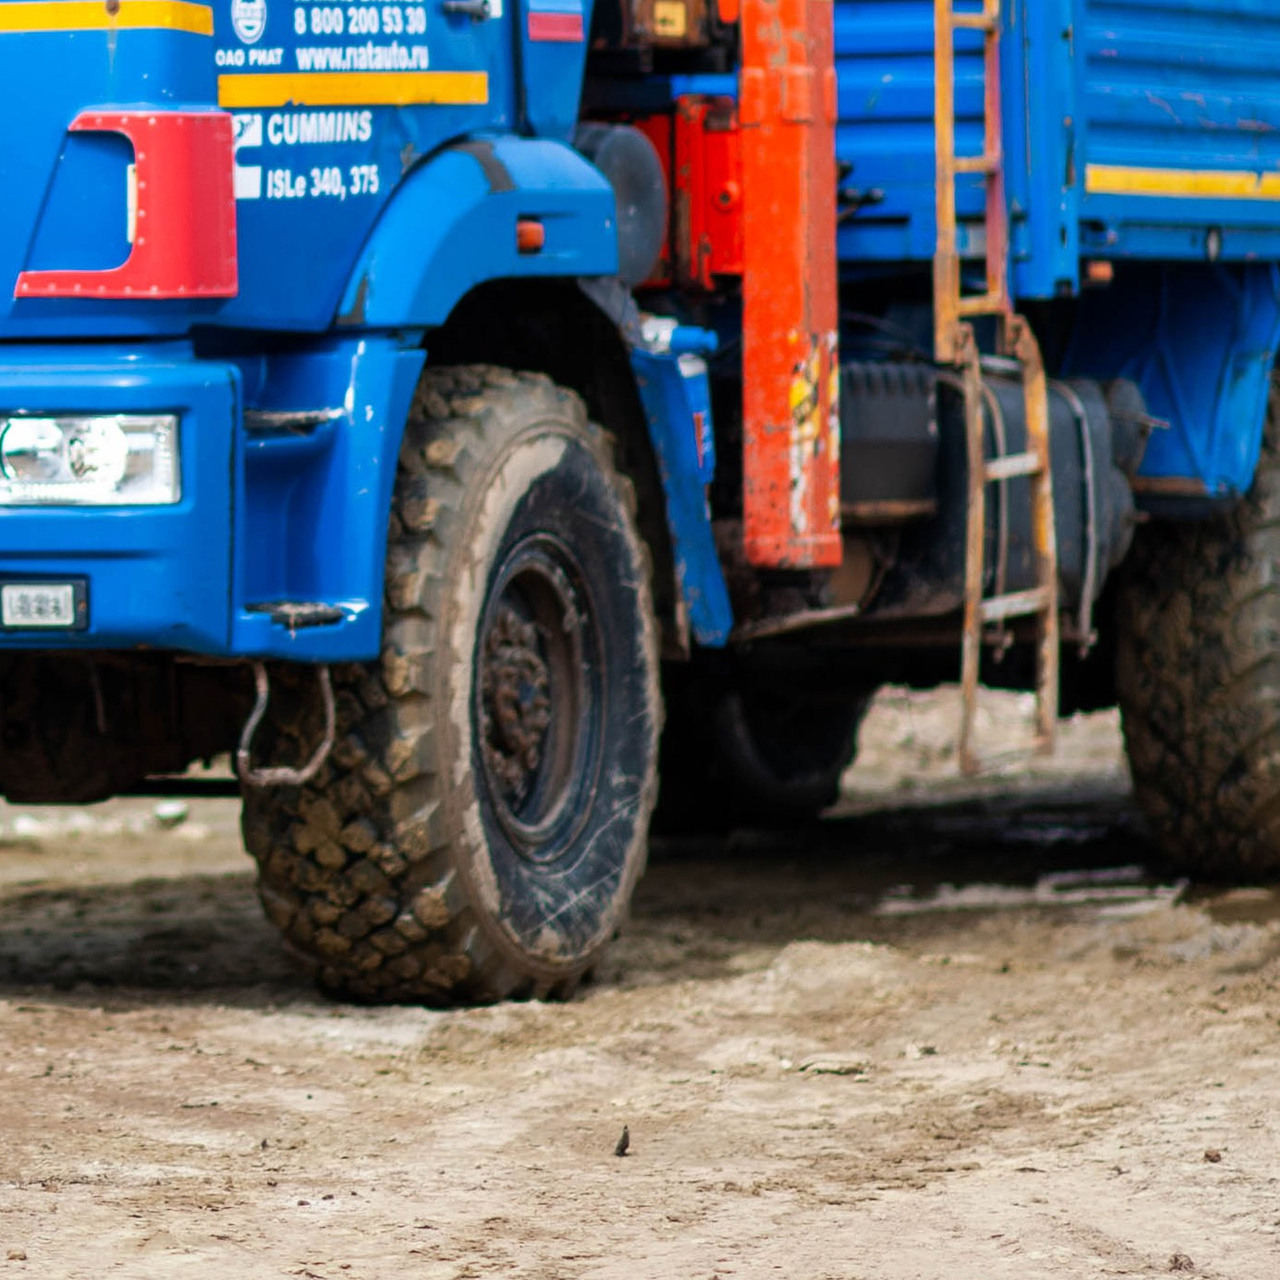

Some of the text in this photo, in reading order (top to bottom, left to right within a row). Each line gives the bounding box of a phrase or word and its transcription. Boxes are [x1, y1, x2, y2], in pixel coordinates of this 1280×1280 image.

[294, 7, 307, 34] 8
[311, 7, 344, 34] 800
[347, 7, 379, 34] 200
[382, 6, 404, 34] 53
[405, 7, 426, 34] 30
[215, 48, 283, 66] ОАО РИАТ
[267, 109, 372, 145] CUMMINS
[267, 164, 379, 201] ISLe 340, 375
